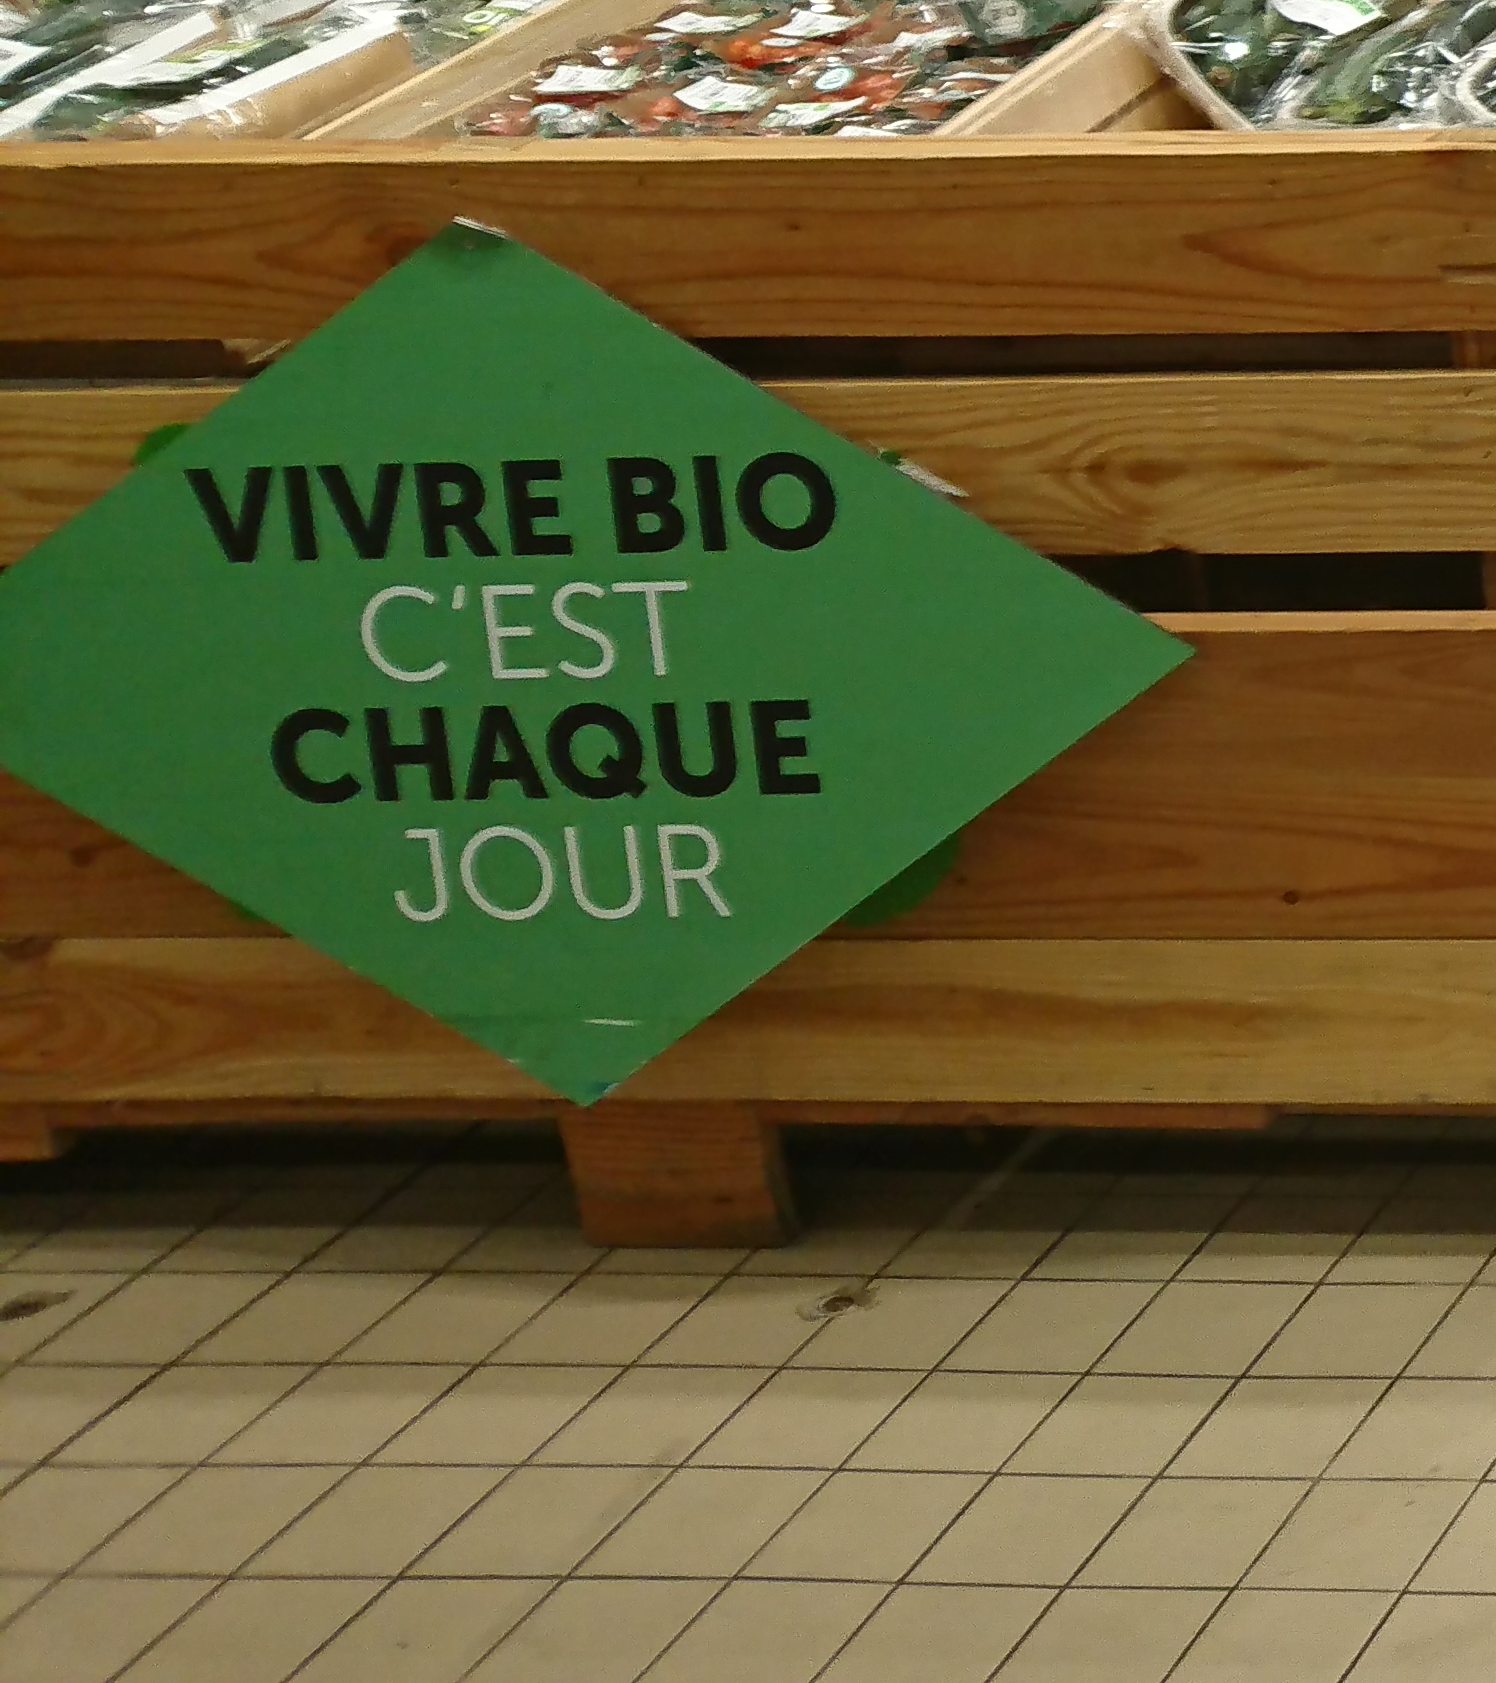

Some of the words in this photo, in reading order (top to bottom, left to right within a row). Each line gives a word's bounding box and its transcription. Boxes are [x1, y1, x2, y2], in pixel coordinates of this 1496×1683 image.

[184, 458, 573, 564] VIVRE
[608, 451, 838, 556] BIO
[359, 580, 690, 684] C'EST
[270, 699, 821, 805] CHAQUE
[393, 823, 732, 924] JOUR
